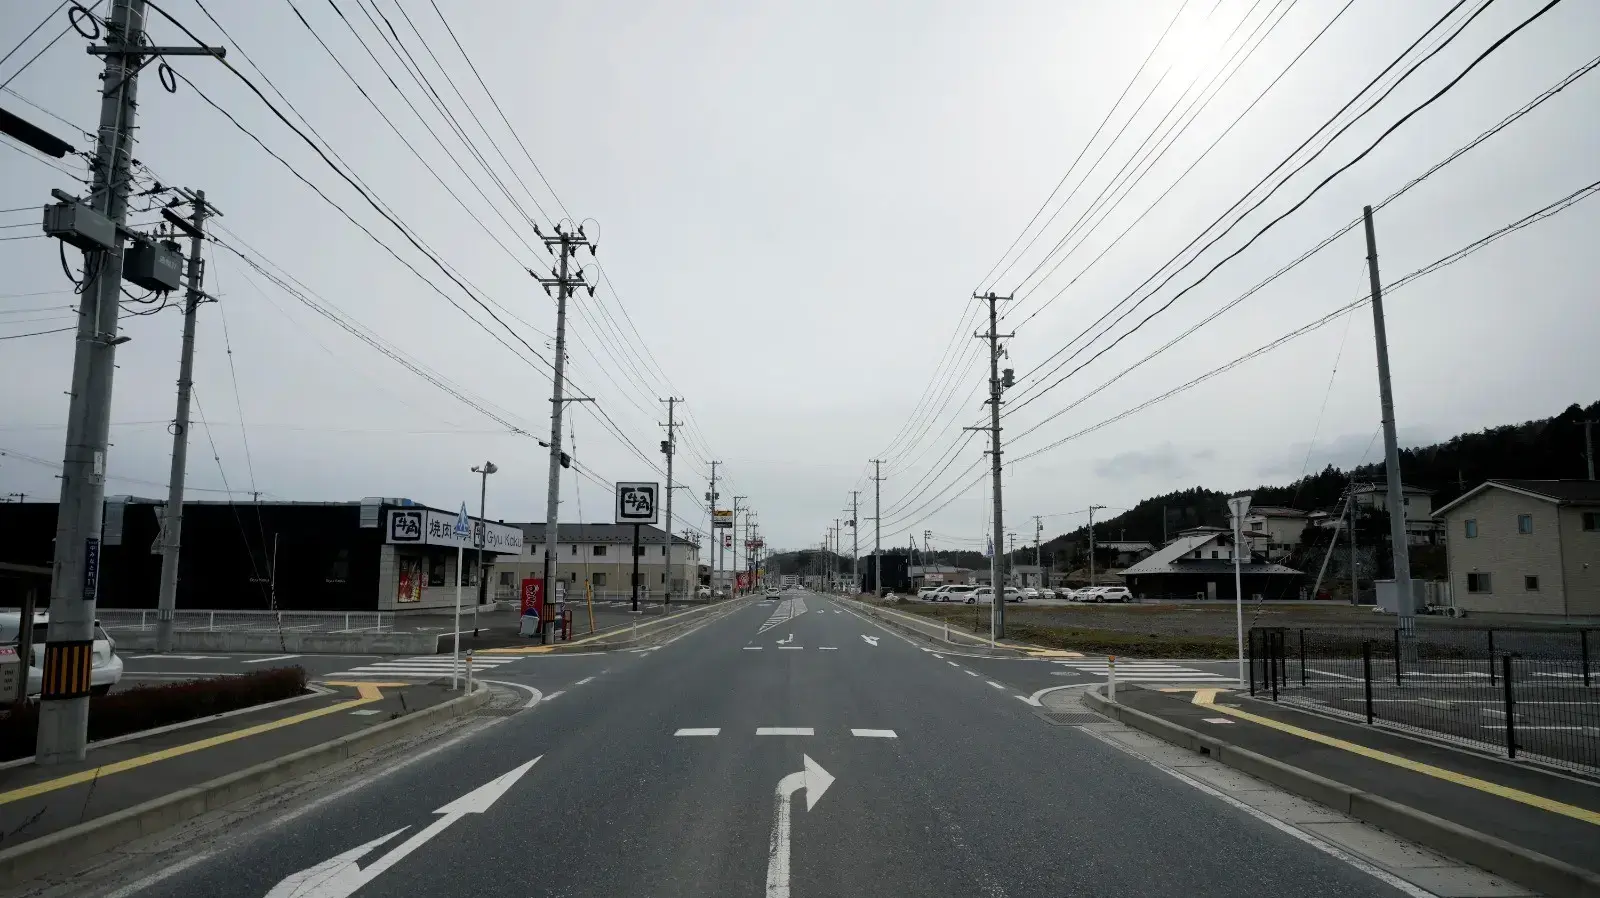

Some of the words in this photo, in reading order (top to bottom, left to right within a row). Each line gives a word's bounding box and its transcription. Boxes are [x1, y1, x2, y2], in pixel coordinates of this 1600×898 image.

[625, 493, 649, 511] 牛角
[395, 517, 418, 535] 牛角
[487, 530, 502, 547] Gyu
